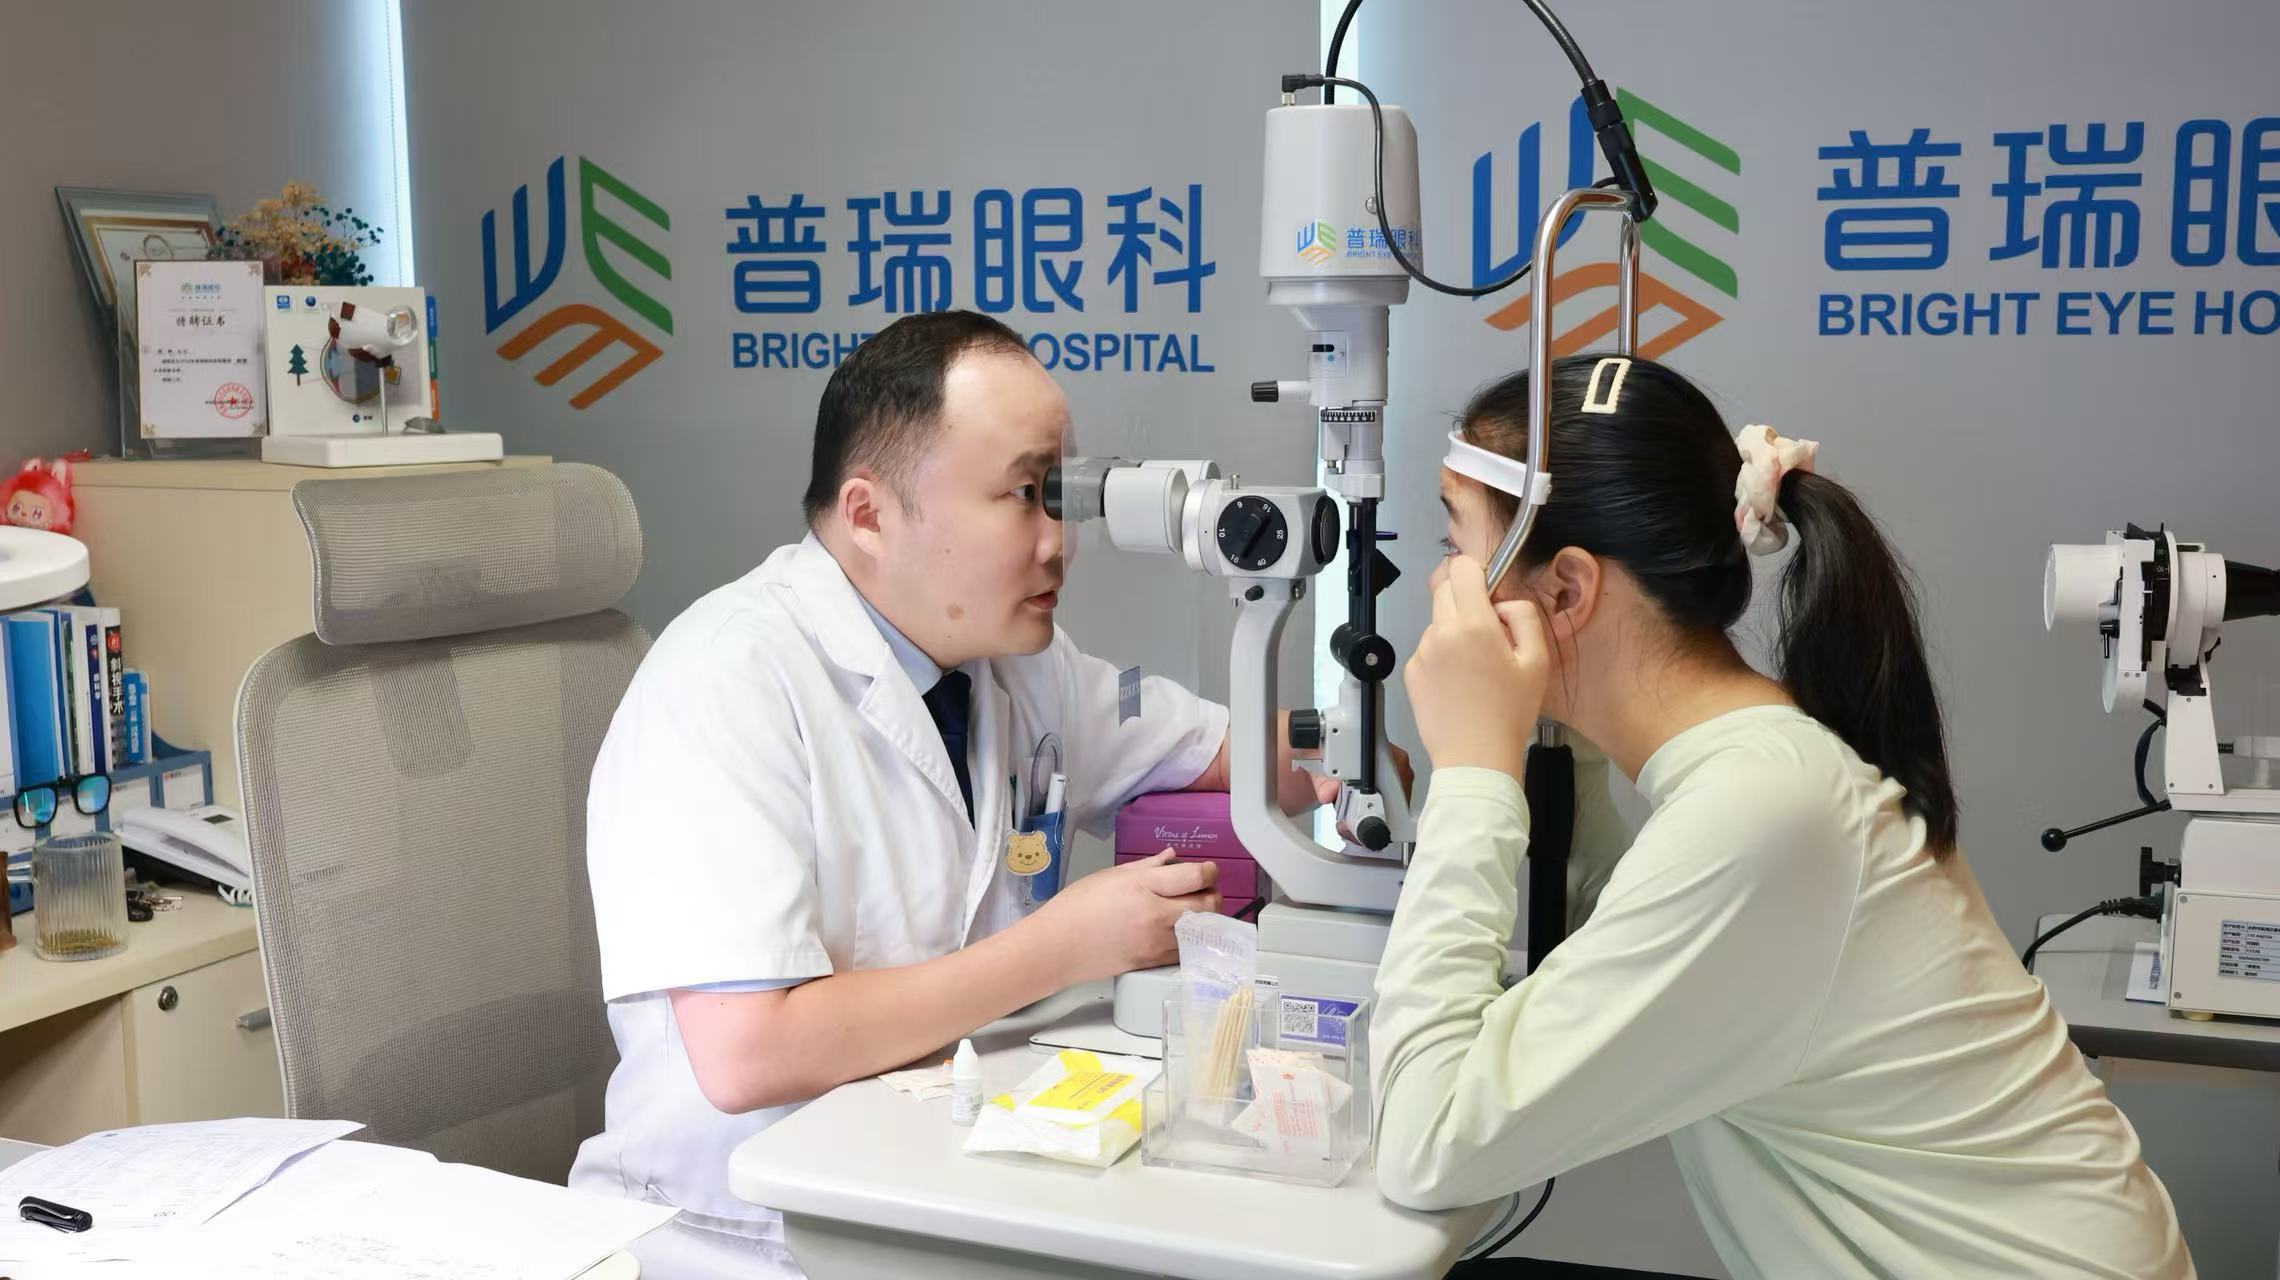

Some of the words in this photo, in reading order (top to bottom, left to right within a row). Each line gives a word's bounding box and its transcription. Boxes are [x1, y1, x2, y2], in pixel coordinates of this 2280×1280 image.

[726, 184, 1216, 313] 普瑞眼科
[1346, 228, 1419, 249] 普瑞眼科
[1818, 293, 2041, 337] BRIGHT
[2056, 291, 2176, 336] EYE
[2194, 289, 2280, 336] HO
[733, 332, 880, 369] BRIGH
[1024, 332, 1215, 373] OSPITAL
[1218, 528, 1226, 538] 10
[1230, 554, 1240, 563] 16
[1257, 558, 1266, 567] 40
